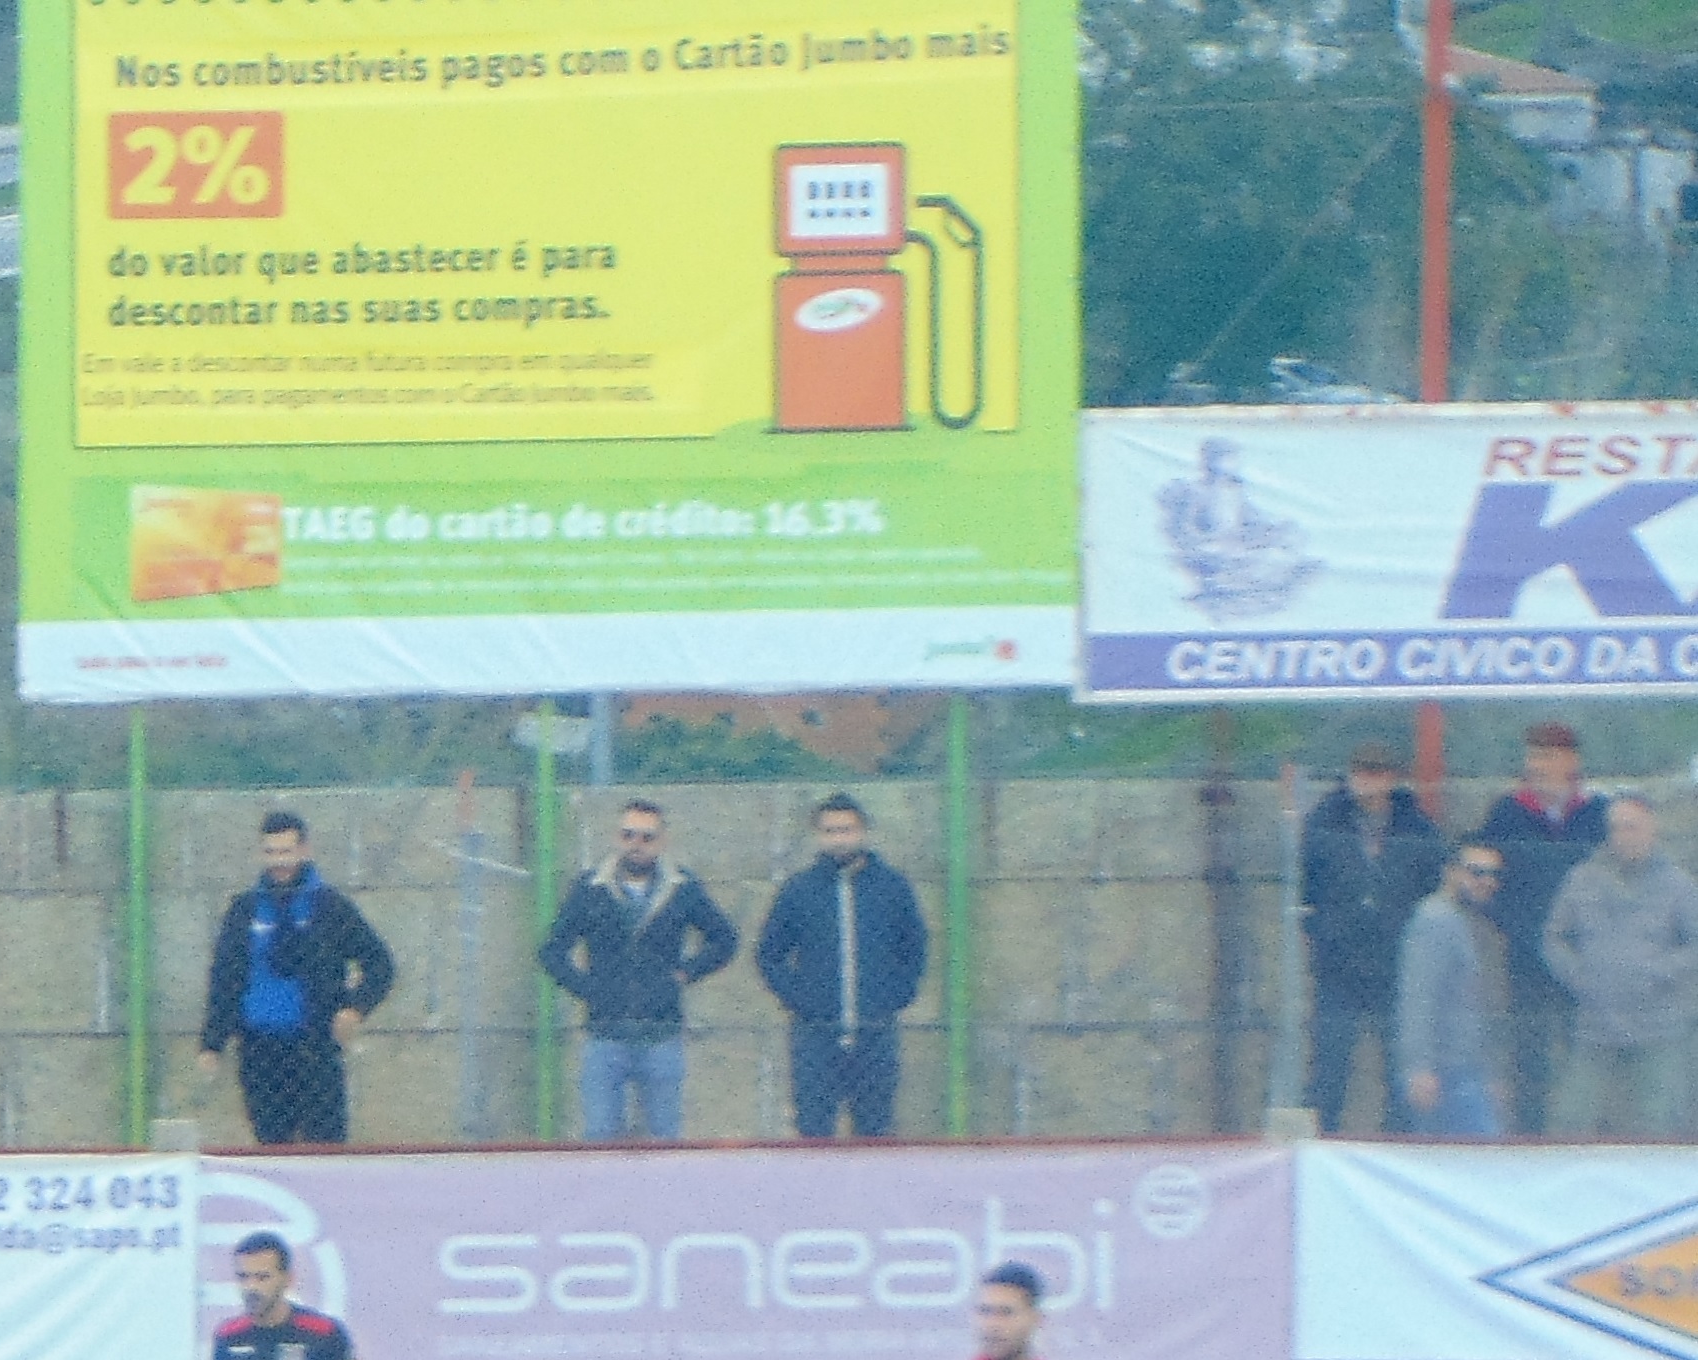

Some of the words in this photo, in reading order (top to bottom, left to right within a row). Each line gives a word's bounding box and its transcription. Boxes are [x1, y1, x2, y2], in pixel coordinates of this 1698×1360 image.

[116, 55, 181, 88] Nos
[194, 48, 428, 88] combustíveis
[441, 51, 547, 89] pagos
[559, 47, 630, 77] com
[643, 46, 661, 72] o
[674, 34, 789, 70] Cartão
[926, 24, 1011, 57] mais
[120, 123, 271, 206] 2%
[108, 246, 147, 278] do
[162, 244, 245, 277] valor
[258, 248, 319, 284] que
[332, 242, 500, 276] abastecer
[511, 241, 527, 271] é
[542, 243, 617, 278] para
[108, 295, 278, 327] descontar
[290, 298, 350, 324] nas
[364, 297, 442, 323] suas
[454, 294, 612, 329] compras.
[285, 506, 377, 540] TAEG
[385, 504, 432, 540] do
[439, 502, 553, 540] cartão
[561, 502, 606, 539] de
[613, 499, 754, 538] crédito:
[1435, 478, 1698, 620] K
[1165, 637, 1387, 683] CENTRO
[1395, 634, 1576, 680] CIVICO
[1586, 633, 1661, 678] DA
[25, 1175, 96, 1210] 324
[107, 1174, 181, 1209] 043
[437, 1196, 1116, 1314] saneabi
